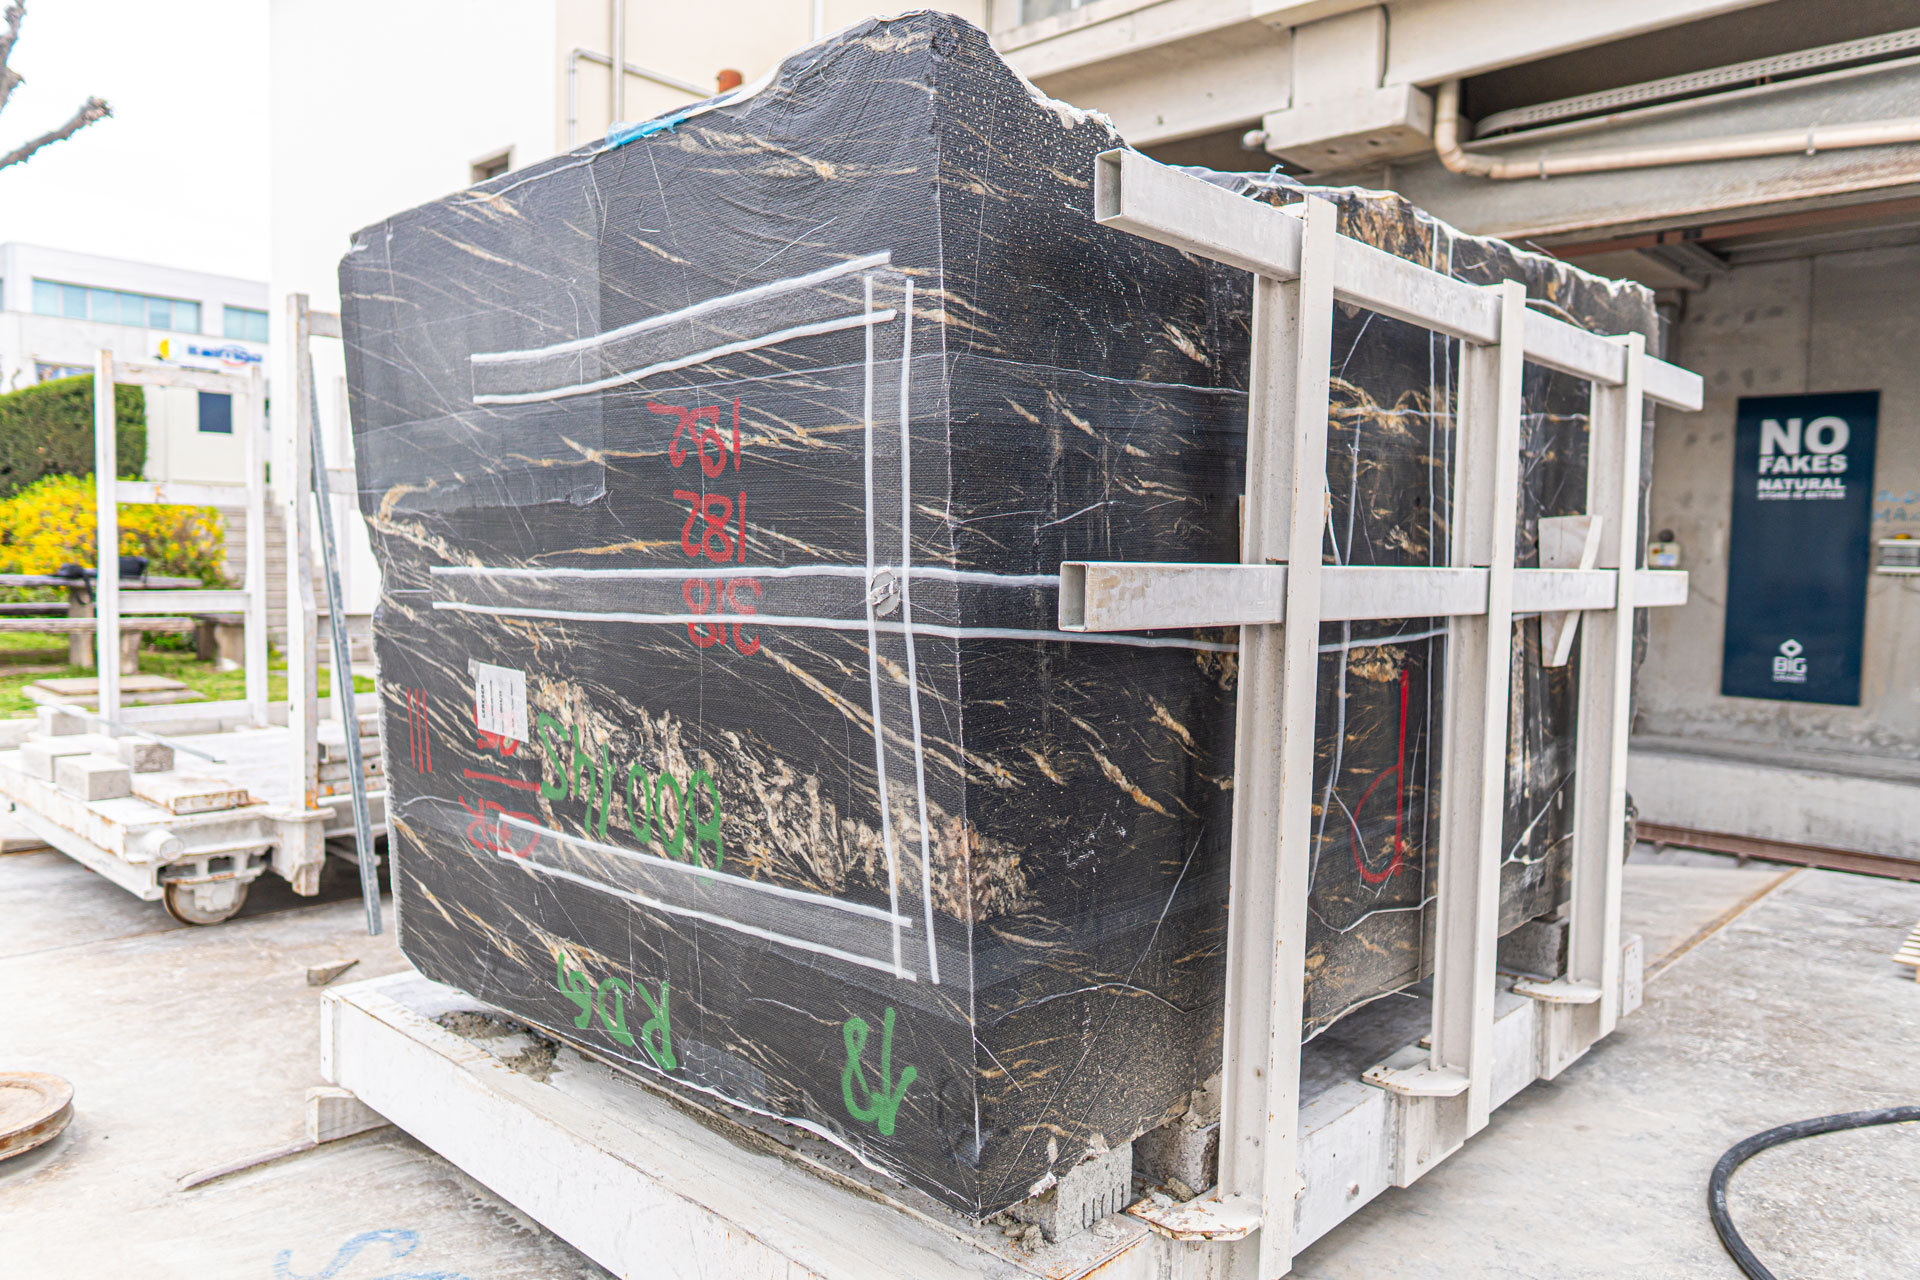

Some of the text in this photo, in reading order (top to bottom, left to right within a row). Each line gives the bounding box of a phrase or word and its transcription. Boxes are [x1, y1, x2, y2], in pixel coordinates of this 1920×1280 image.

[646, 397, 741, 479] 192
[1759, 416, 1850, 455] NO
[1757, 477, 1846, 491] NATURAL
[1758, 454, 1848, 475] FAKES
[673, 489, 747, 564] 182
[682, 577, 762, 656] 318
[1773, 655, 1807, 674] BIG
